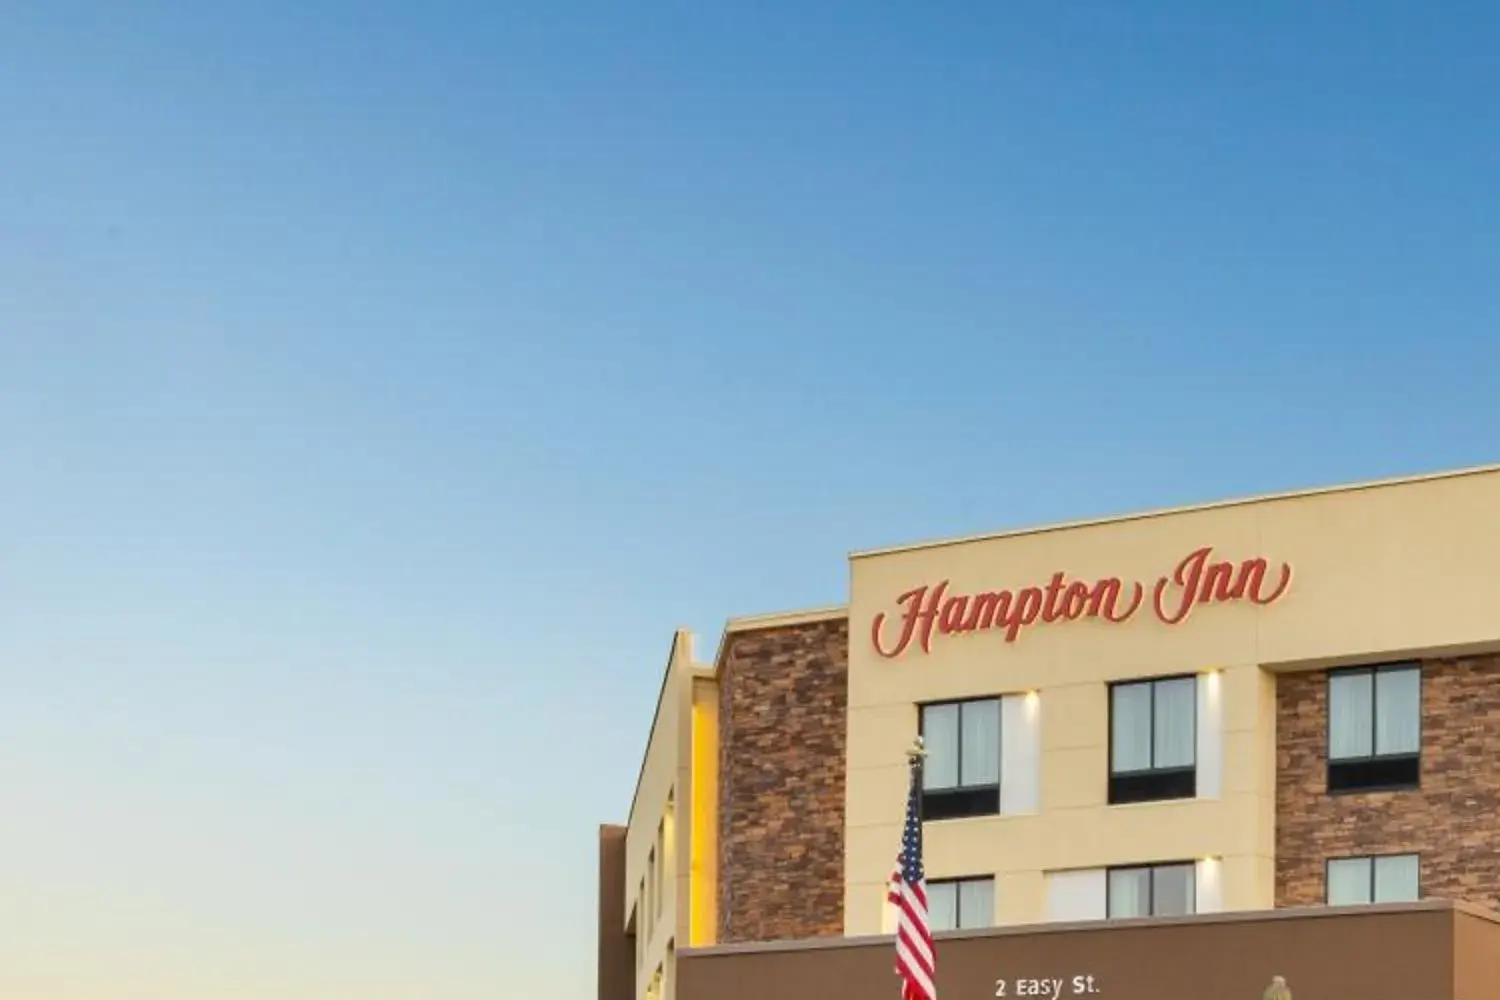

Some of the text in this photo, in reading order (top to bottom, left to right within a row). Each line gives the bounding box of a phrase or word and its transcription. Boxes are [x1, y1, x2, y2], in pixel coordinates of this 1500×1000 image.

[871, 546, 1291, 659] Hampton Inn
[995, 975, 1100, 1000] 2 Easy St.
